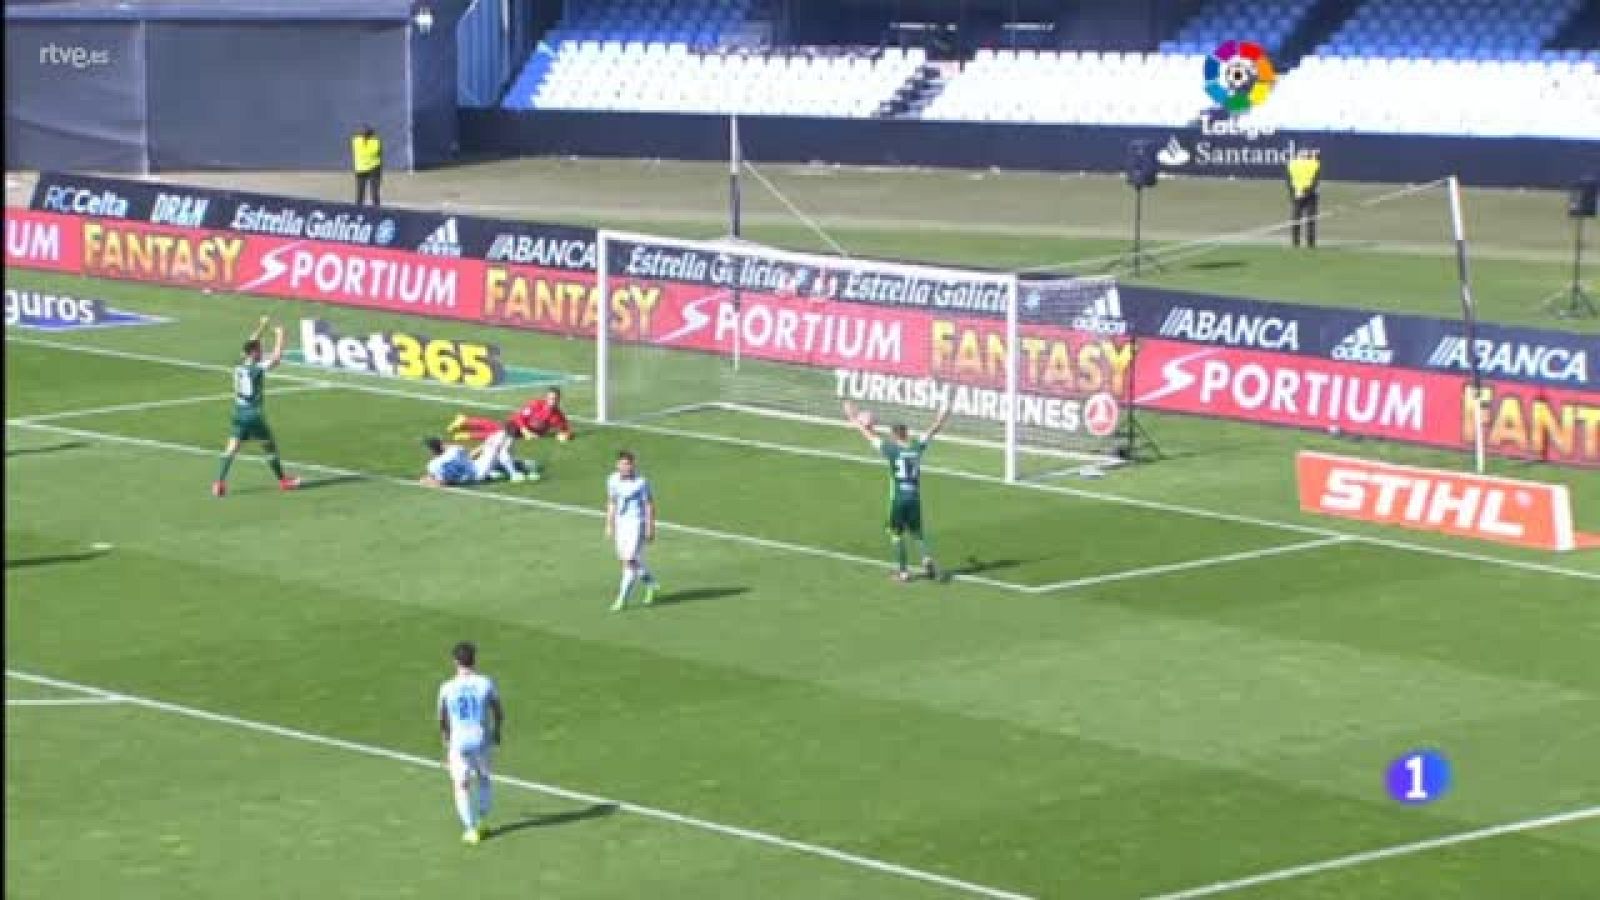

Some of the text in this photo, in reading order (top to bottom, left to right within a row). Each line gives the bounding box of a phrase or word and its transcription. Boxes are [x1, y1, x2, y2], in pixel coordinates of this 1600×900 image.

[82, 221, 244, 281] FANTASY
[231, 203, 372, 243] Estrella Galicia
[238, 240, 458, 308] SPORTIUM
[484, 266, 661, 332] FANTASY
[625, 247, 784, 292] Estrella Glicia
[843, 272, 931, 305] Estrella
[5, 289, 96, 326] guros
[652, 291, 902, 363] SPORTIUM
[300, 318, 494, 388] bet365
[931, 320, 1134, 396] FANTASY
[835, 369, 950, 411] TURKISH
[1134, 347, 1426, 431] SPORTIUM
[1463, 385, 1600, 457] FANT
[1319, 467, 1525, 537] STIHL
